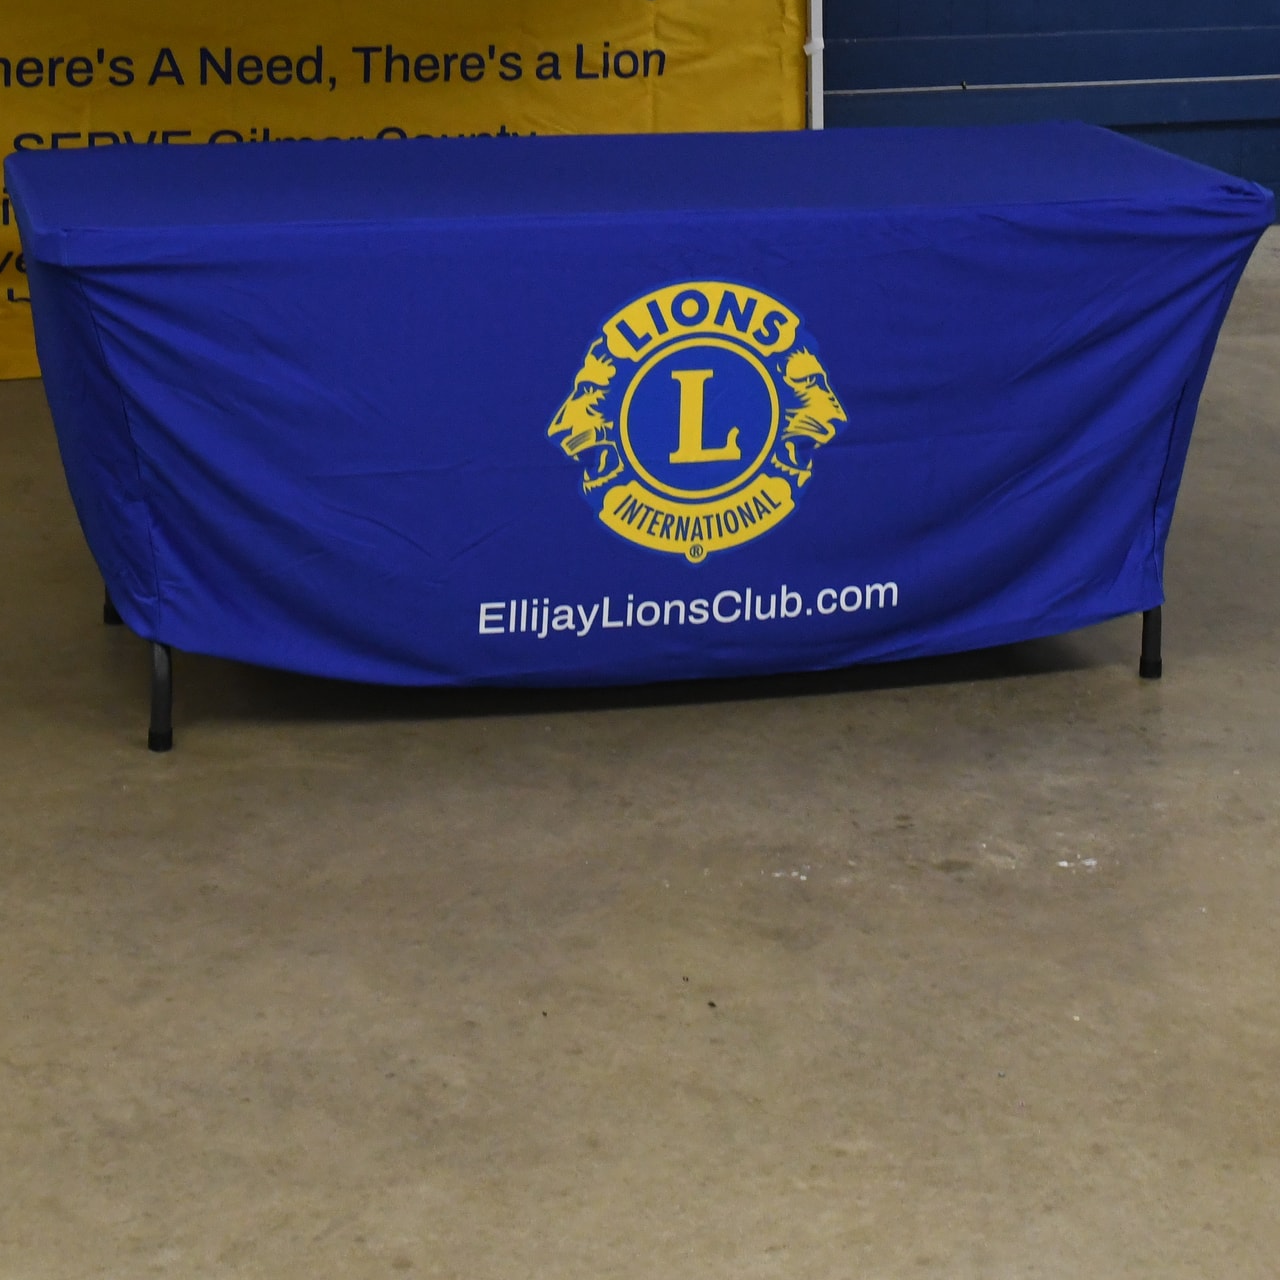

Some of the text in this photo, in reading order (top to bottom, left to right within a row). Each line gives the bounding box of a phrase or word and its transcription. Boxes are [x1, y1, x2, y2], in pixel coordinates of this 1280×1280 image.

[148, 48, 186, 86] A
[200, 45, 337, 91] Need,
[352, 45, 522, 84] There's
[535, 53, 562, 80] a
[576, 42, 667, 80] Lion
[615, 288, 789, 353] LIONS
[669, 369, 741, 464] L
[613, 488, 781, 542] INTERNATIONAL
[478, 580, 898, 638] EllijayLionsClub.com
